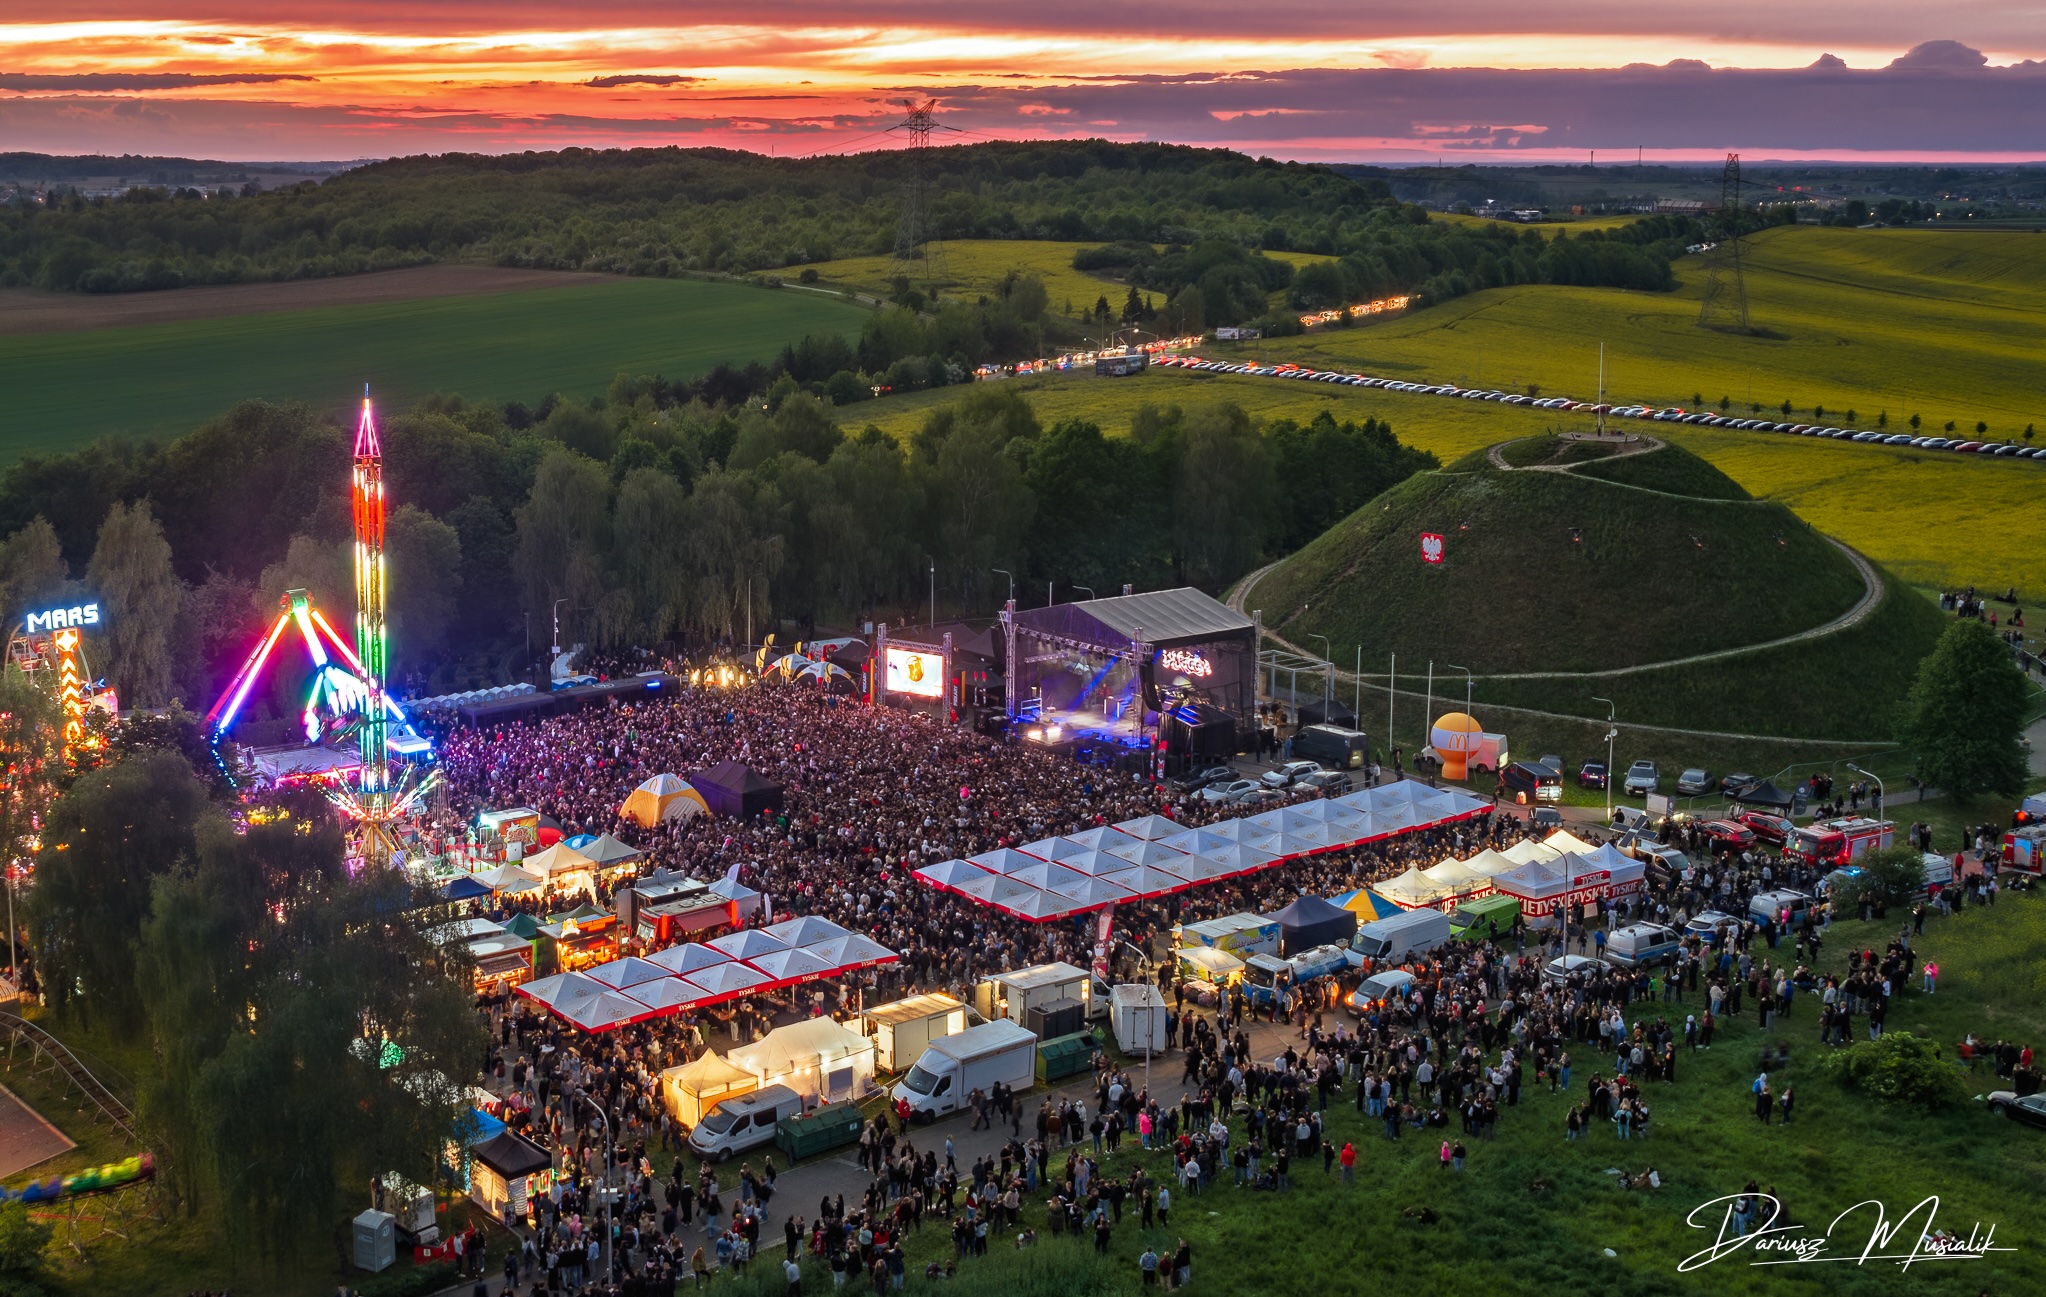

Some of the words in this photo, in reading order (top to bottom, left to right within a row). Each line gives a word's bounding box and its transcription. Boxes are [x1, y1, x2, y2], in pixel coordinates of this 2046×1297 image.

[27, 603, 99, 633] MARS
[1581, 873, 1604, 885] TYSKIE
[1611, 881, 1639, 897] TYSKIE
[1535, 892, 1574, 915] TYSKE
[801, 973, 820, 982] TYSKIE
[738, 987, 756, 997] TYSKIE
[678, 1001, 697, 1011] TYSKIE
[614, 1018, 631, 1027] TYSKIE
